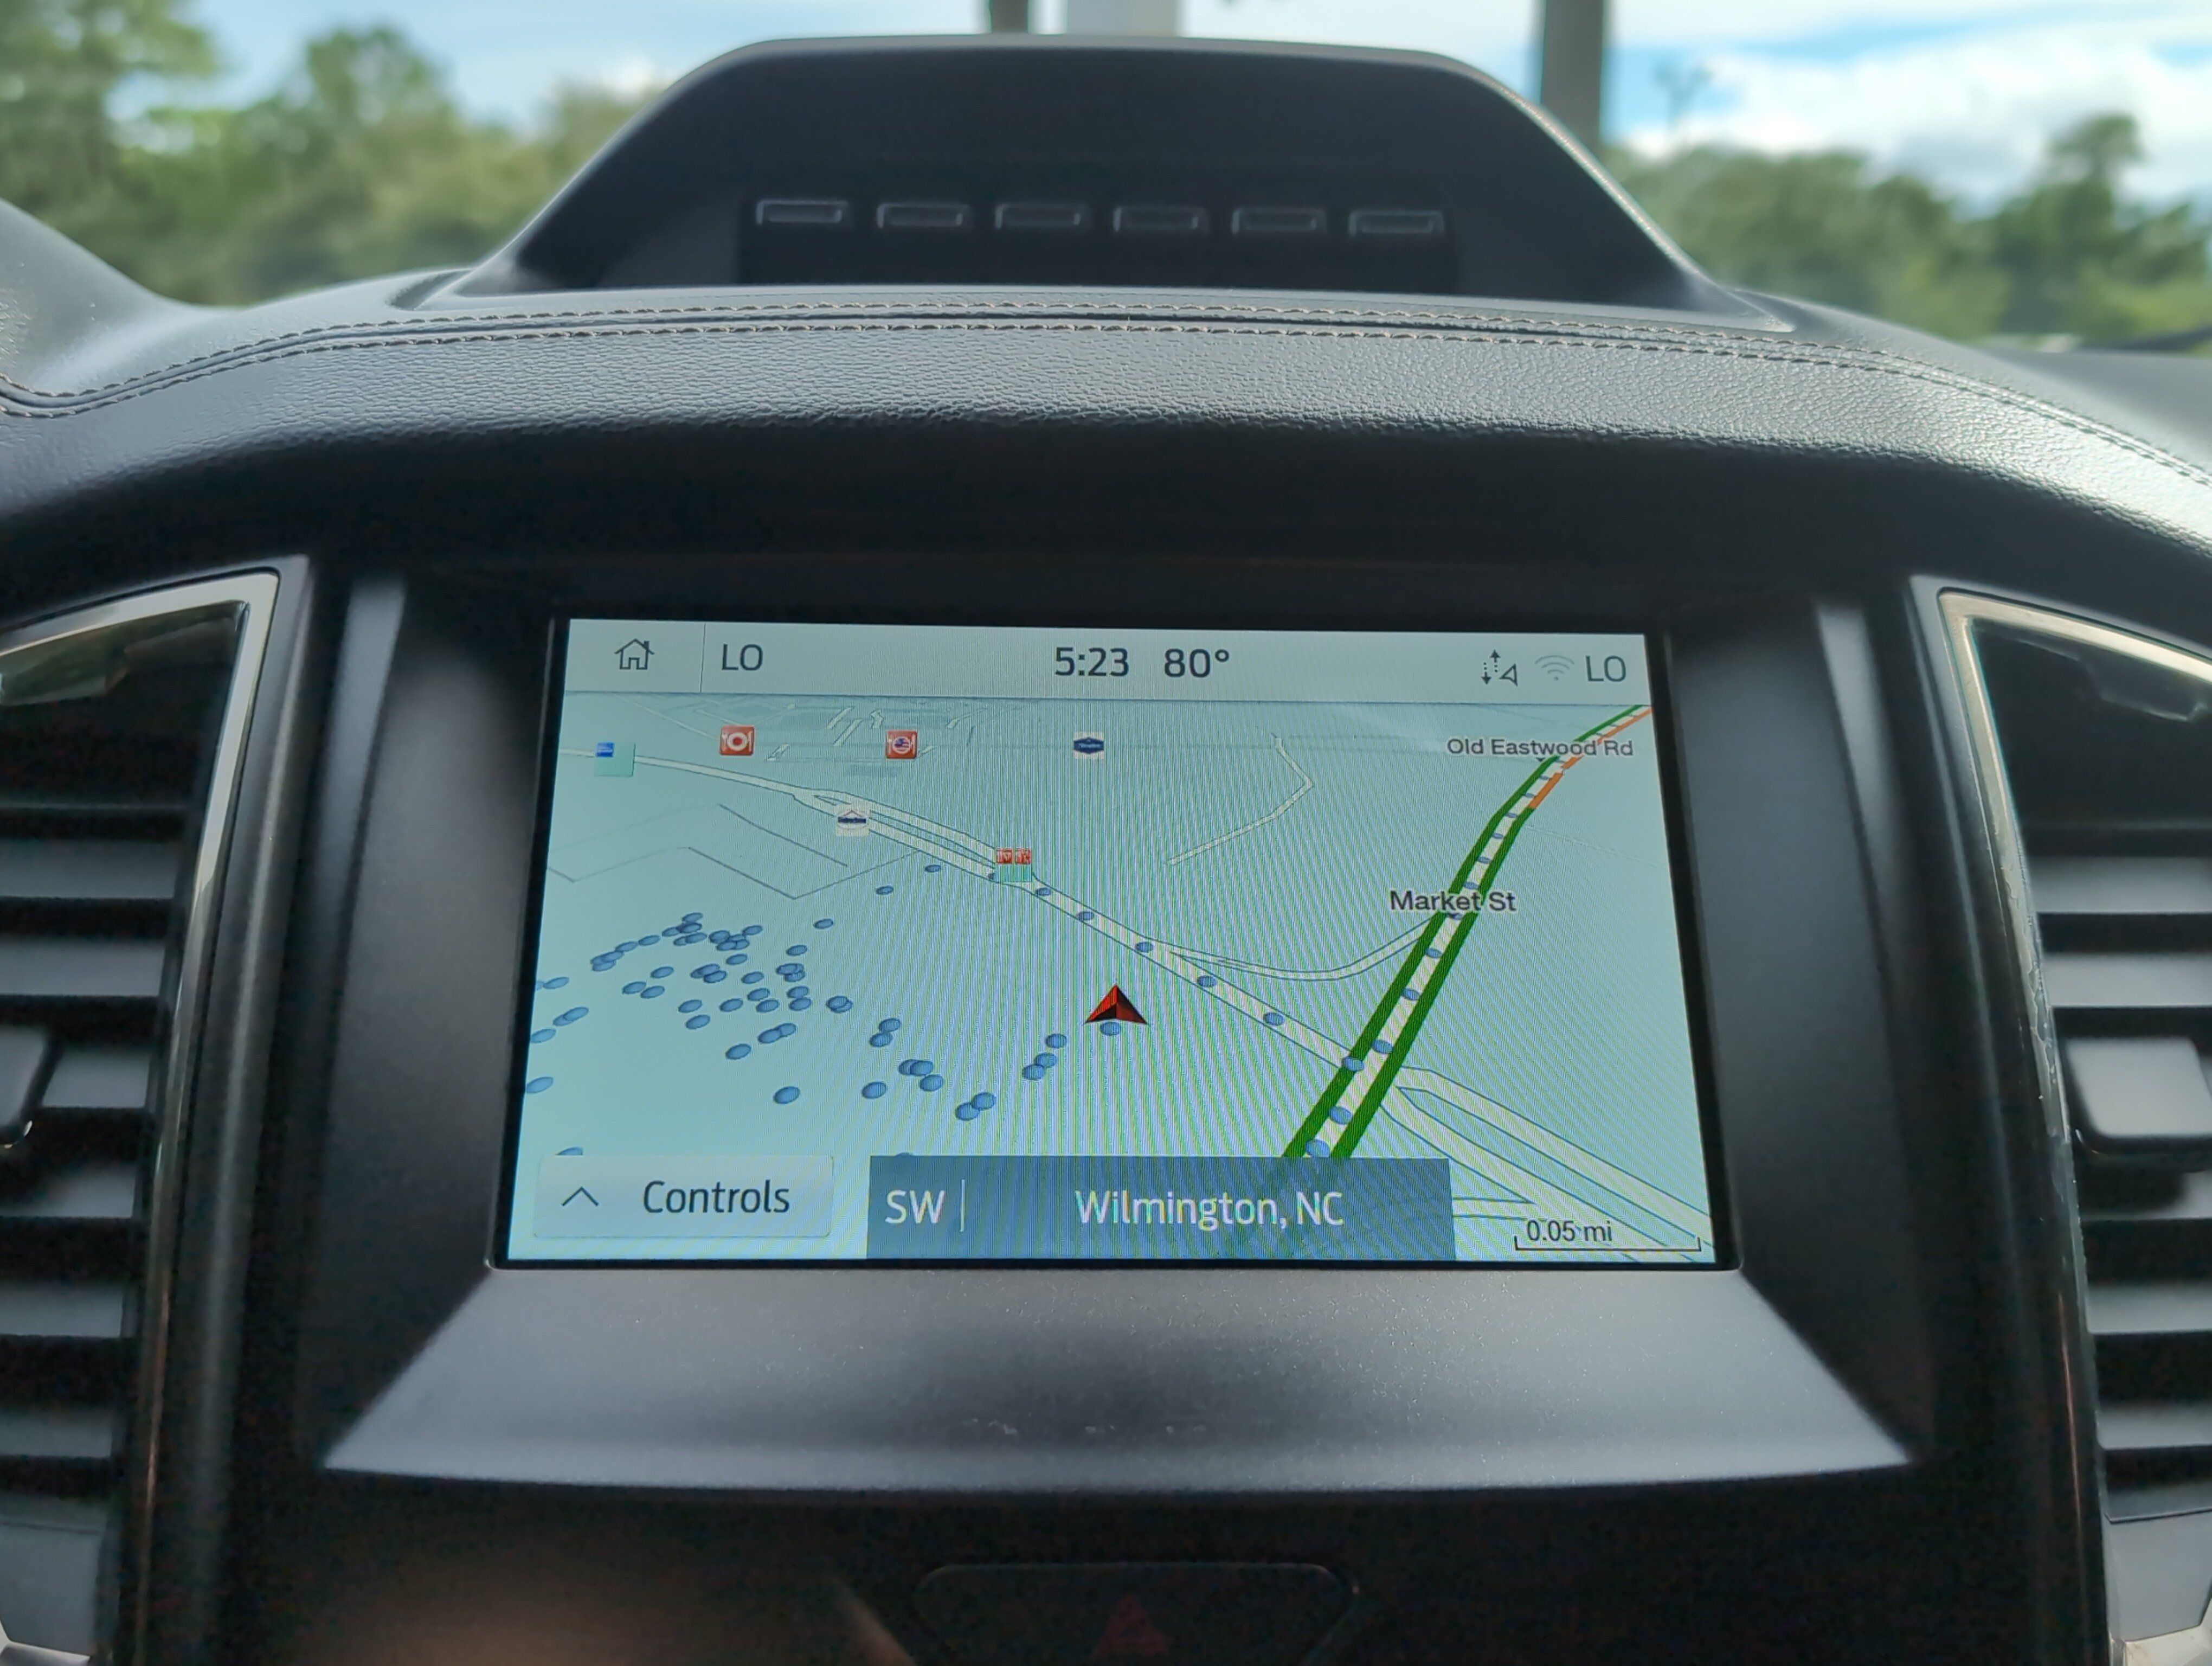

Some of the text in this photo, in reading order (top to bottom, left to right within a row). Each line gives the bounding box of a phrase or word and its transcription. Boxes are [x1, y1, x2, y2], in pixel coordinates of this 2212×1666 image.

[722, 644, 763, 670] LO
[1055, 647, 1129, 676] 5:23
[1165, 649, 1230, 677] 80°
[1586, 655, 1626, 682] LO
[1447, 739, 1633, 756] Old Eastwood Rd
[1390, 890, 1516, 911] Market St
[643, 1180, 790, 1213] Controls
[885, 1189, 945, 1224] SW
[1075, 1190, 1343, 1232] Wilmington, NC
[1527, 1220, 1612, 1241] 0.05 mi
